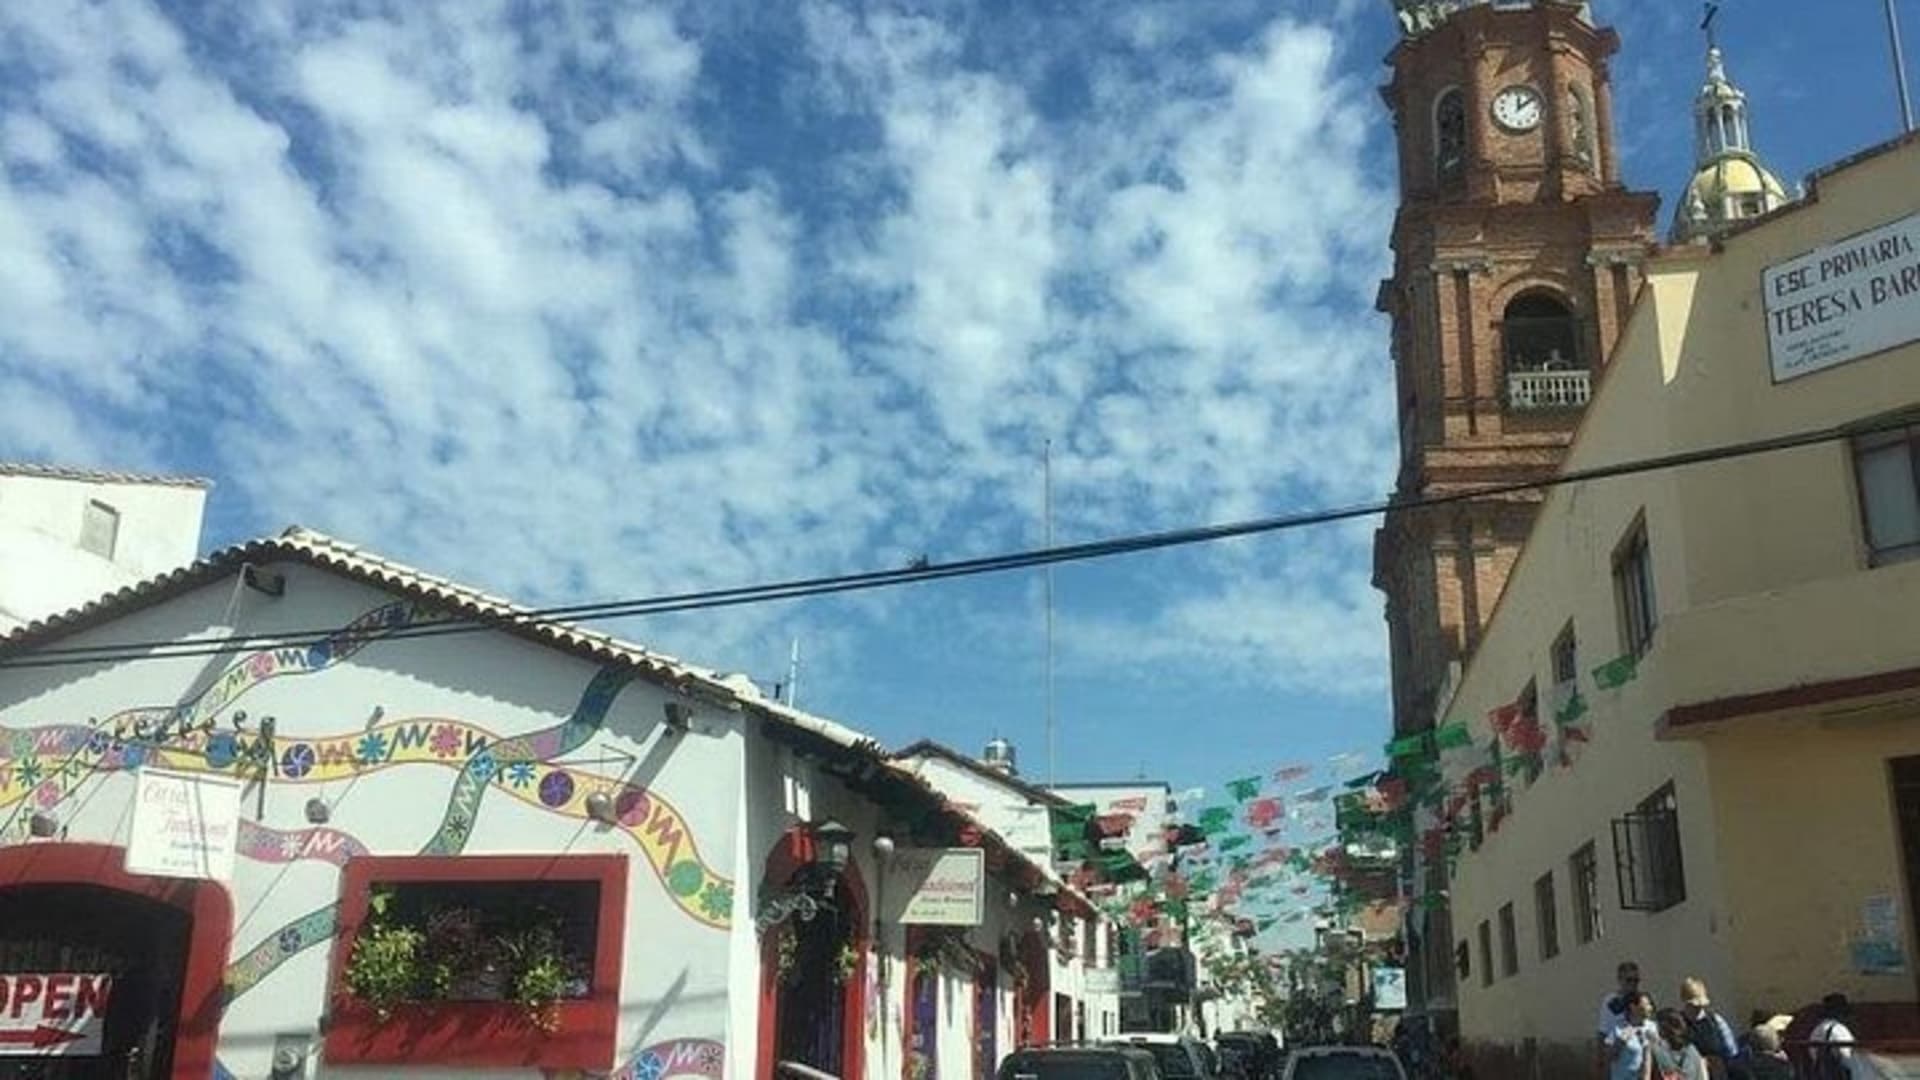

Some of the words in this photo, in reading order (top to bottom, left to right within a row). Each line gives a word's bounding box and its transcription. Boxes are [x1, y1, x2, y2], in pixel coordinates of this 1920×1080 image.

[1819, 233, 1914, 283] PRIMARIA
[1772, 288, 1863, 336] TERESA
[1870, 262, 1920, 305] BAR
